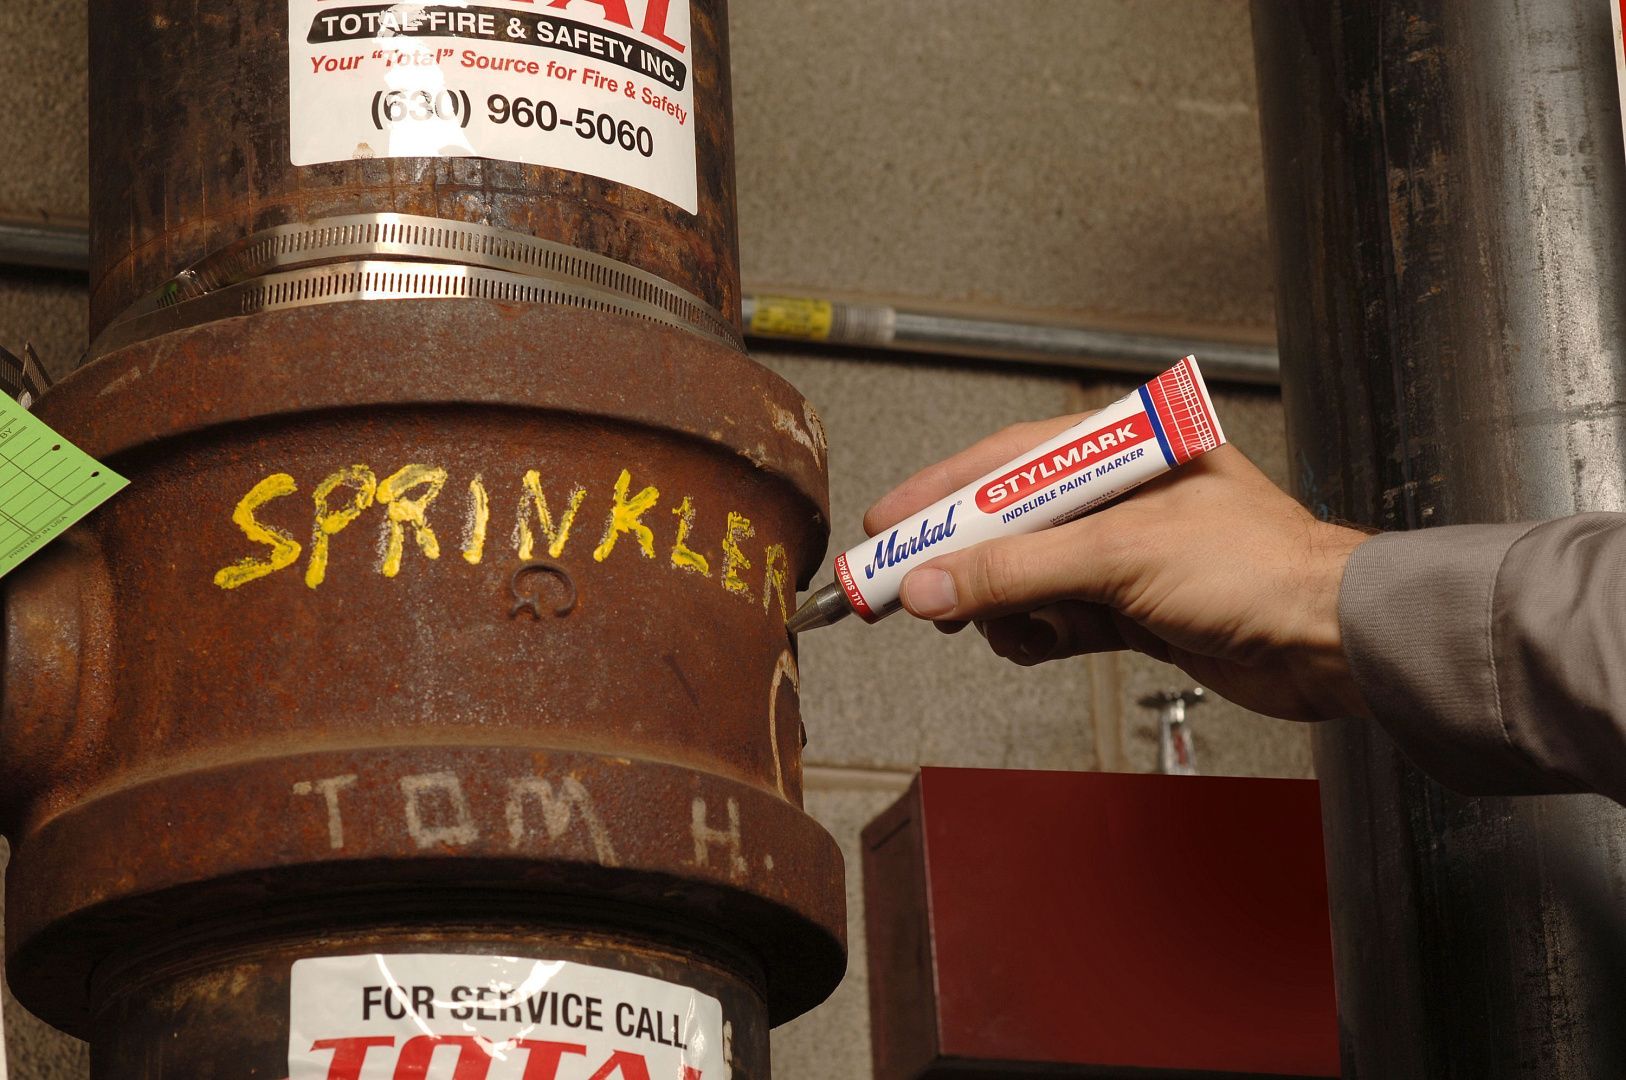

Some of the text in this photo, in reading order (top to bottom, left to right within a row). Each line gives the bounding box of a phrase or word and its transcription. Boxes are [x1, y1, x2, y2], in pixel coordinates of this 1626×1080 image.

[321, 12, 418, 37] TOTAL
[430, 12, 495, 35] FIRE
[506, 17, 526, 39] &
[537, 21, 633, 63] SAFETY
[640, 49, 680, 86] INC.
[311, 55, 364, 73] Your
[460, 50, 539, 75] Source
[547, 60, 577, 81] for
[582, 68, 618, 92] Fire
[624, 80, 636, 100] &
[641, 87, 687, 126] Safety
[371, 89, 654, 158] (630) 960-5060
[986, 422, 1138, 504] STYLMARK
[1002, 489, 1057, 524] INDELIBLE
[1059, 471, 1092, 495] PAINT
[1096, 448, 1144, 477] MARKER
[50, 516, 68, 530] USA
[213, 463, 788, 625] SPRINKLER
[865, 502, 957, 579] Markal
[851, 592, 865, 606] ALL
[363, 986, 434, 1020] FOR
[450, 986, 603, 1031] SERVICE
